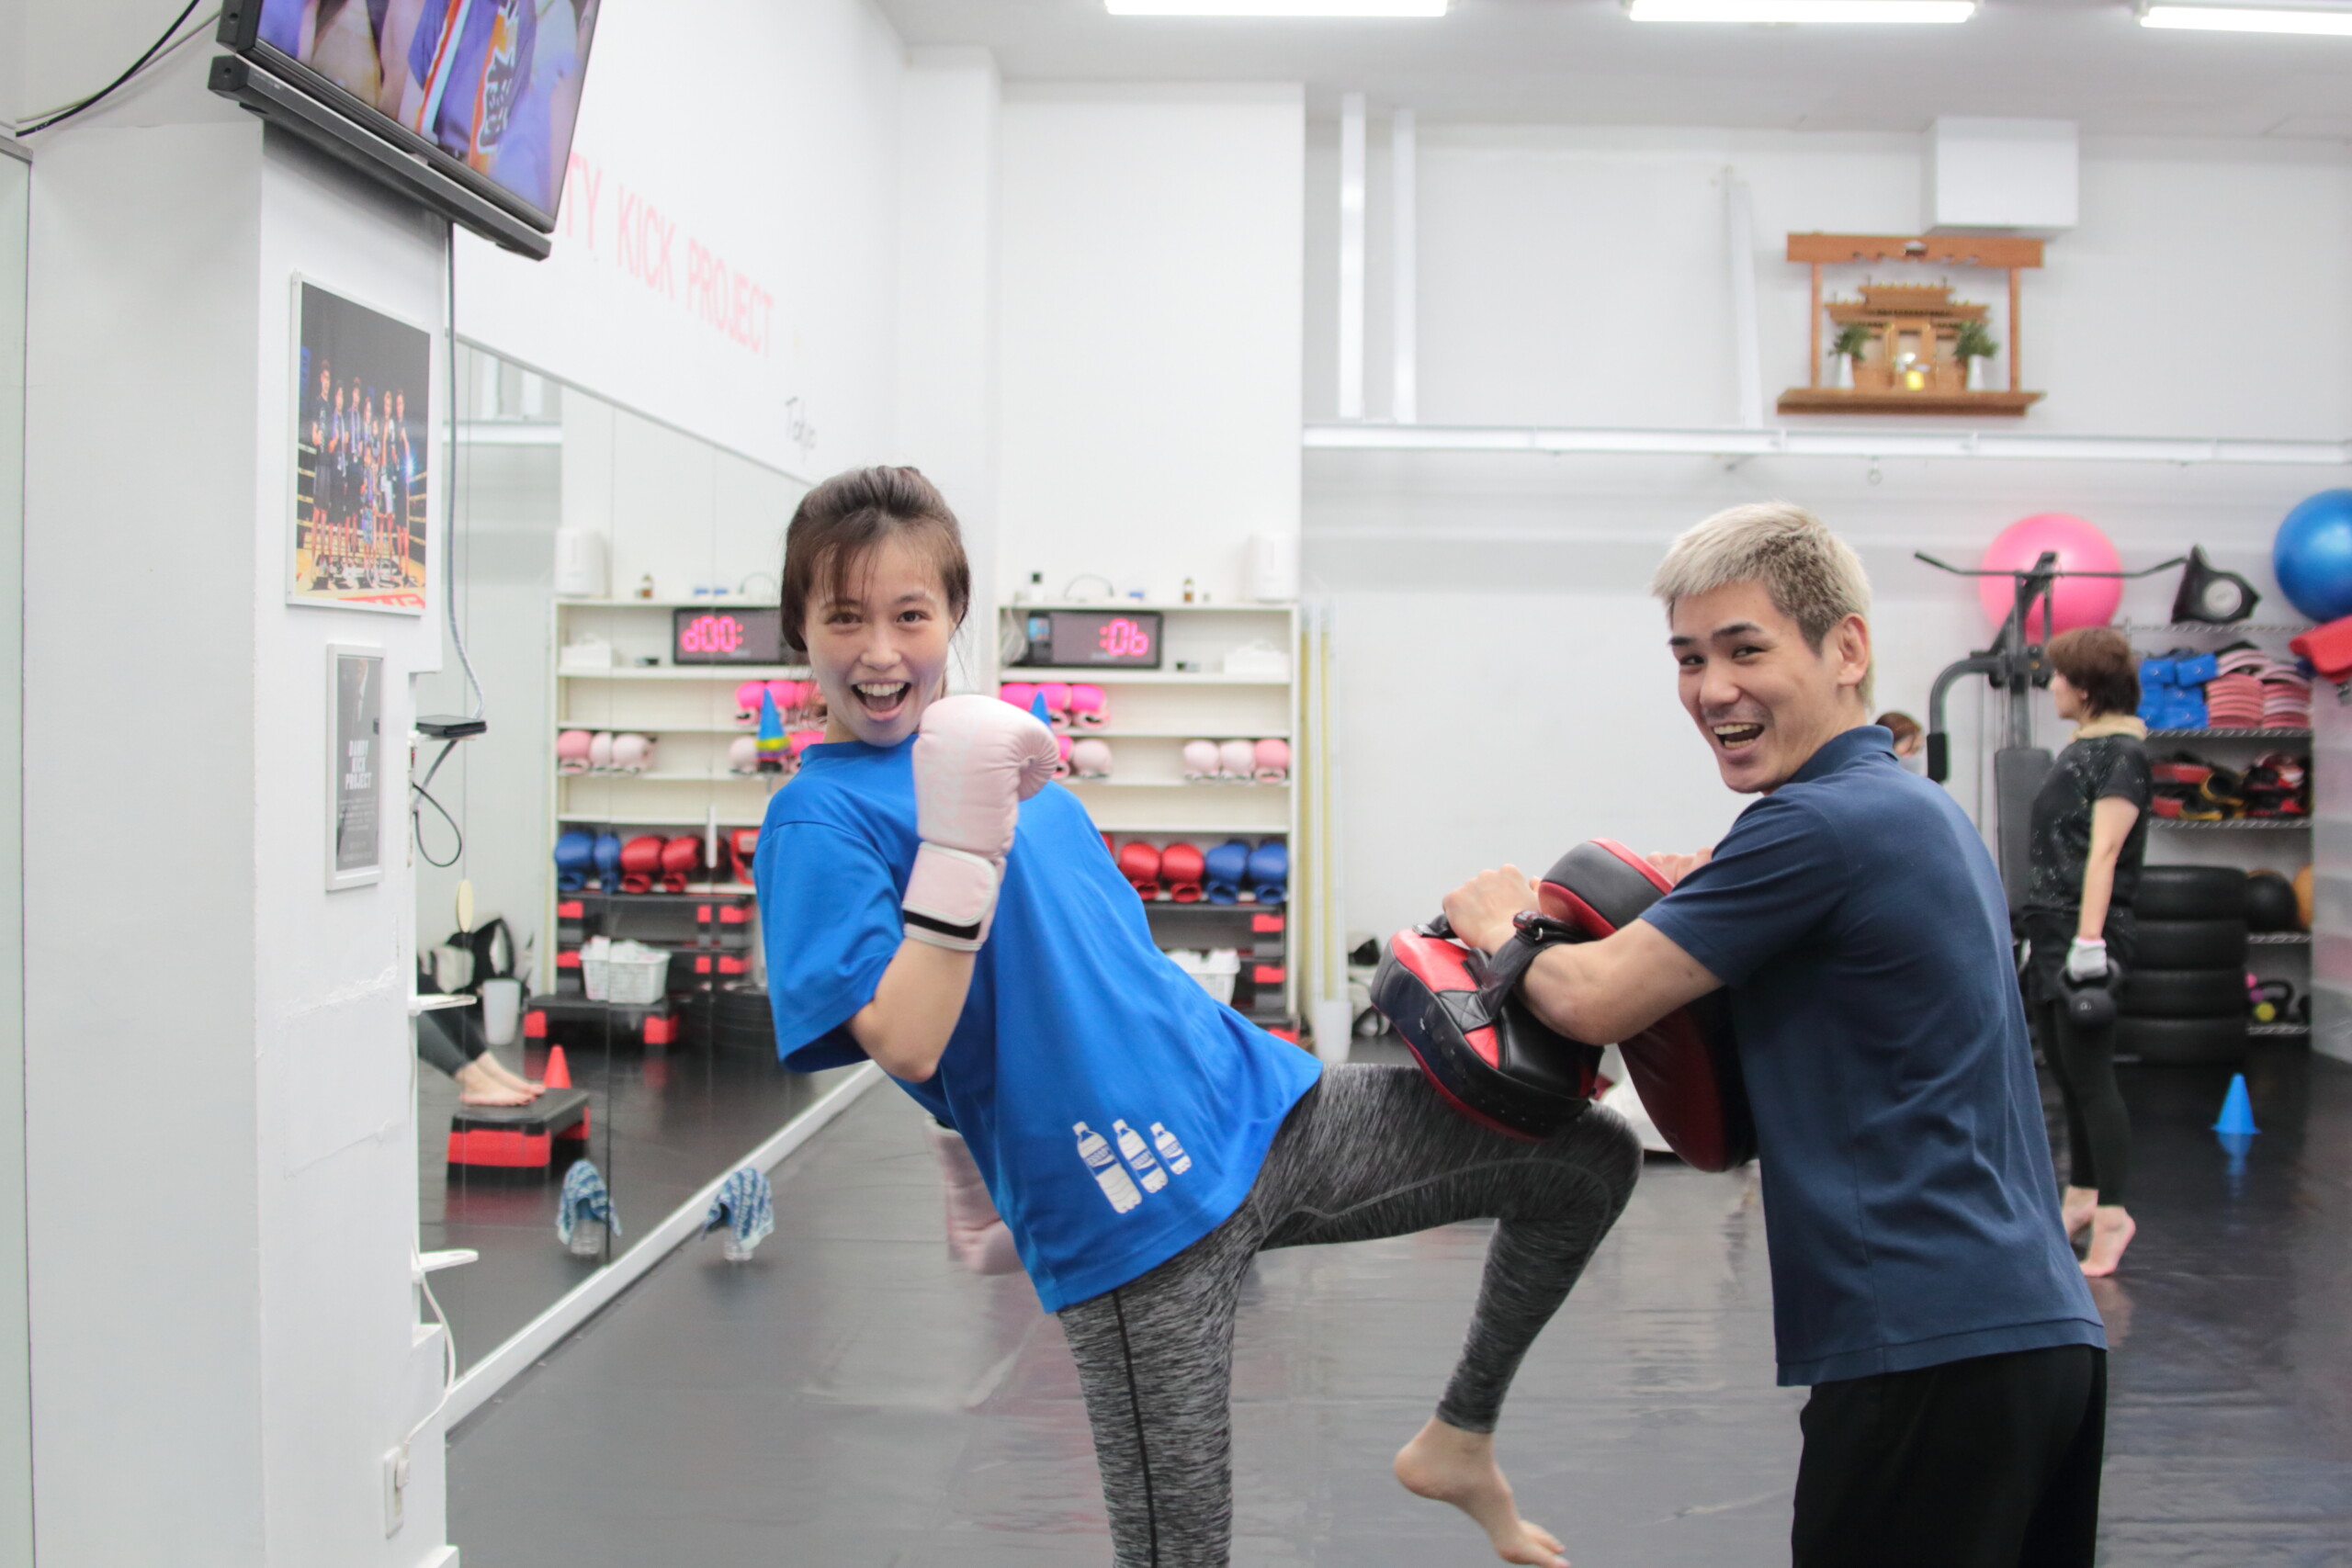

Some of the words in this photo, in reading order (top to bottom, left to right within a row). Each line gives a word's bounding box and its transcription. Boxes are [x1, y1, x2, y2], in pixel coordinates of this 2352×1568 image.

[616, 183, 676, 300] KICK
[685, 237, 775, 358] PROJECT
[351, 756, 367, 773] KICK
[345, 772, 372, 791] PROJECT
